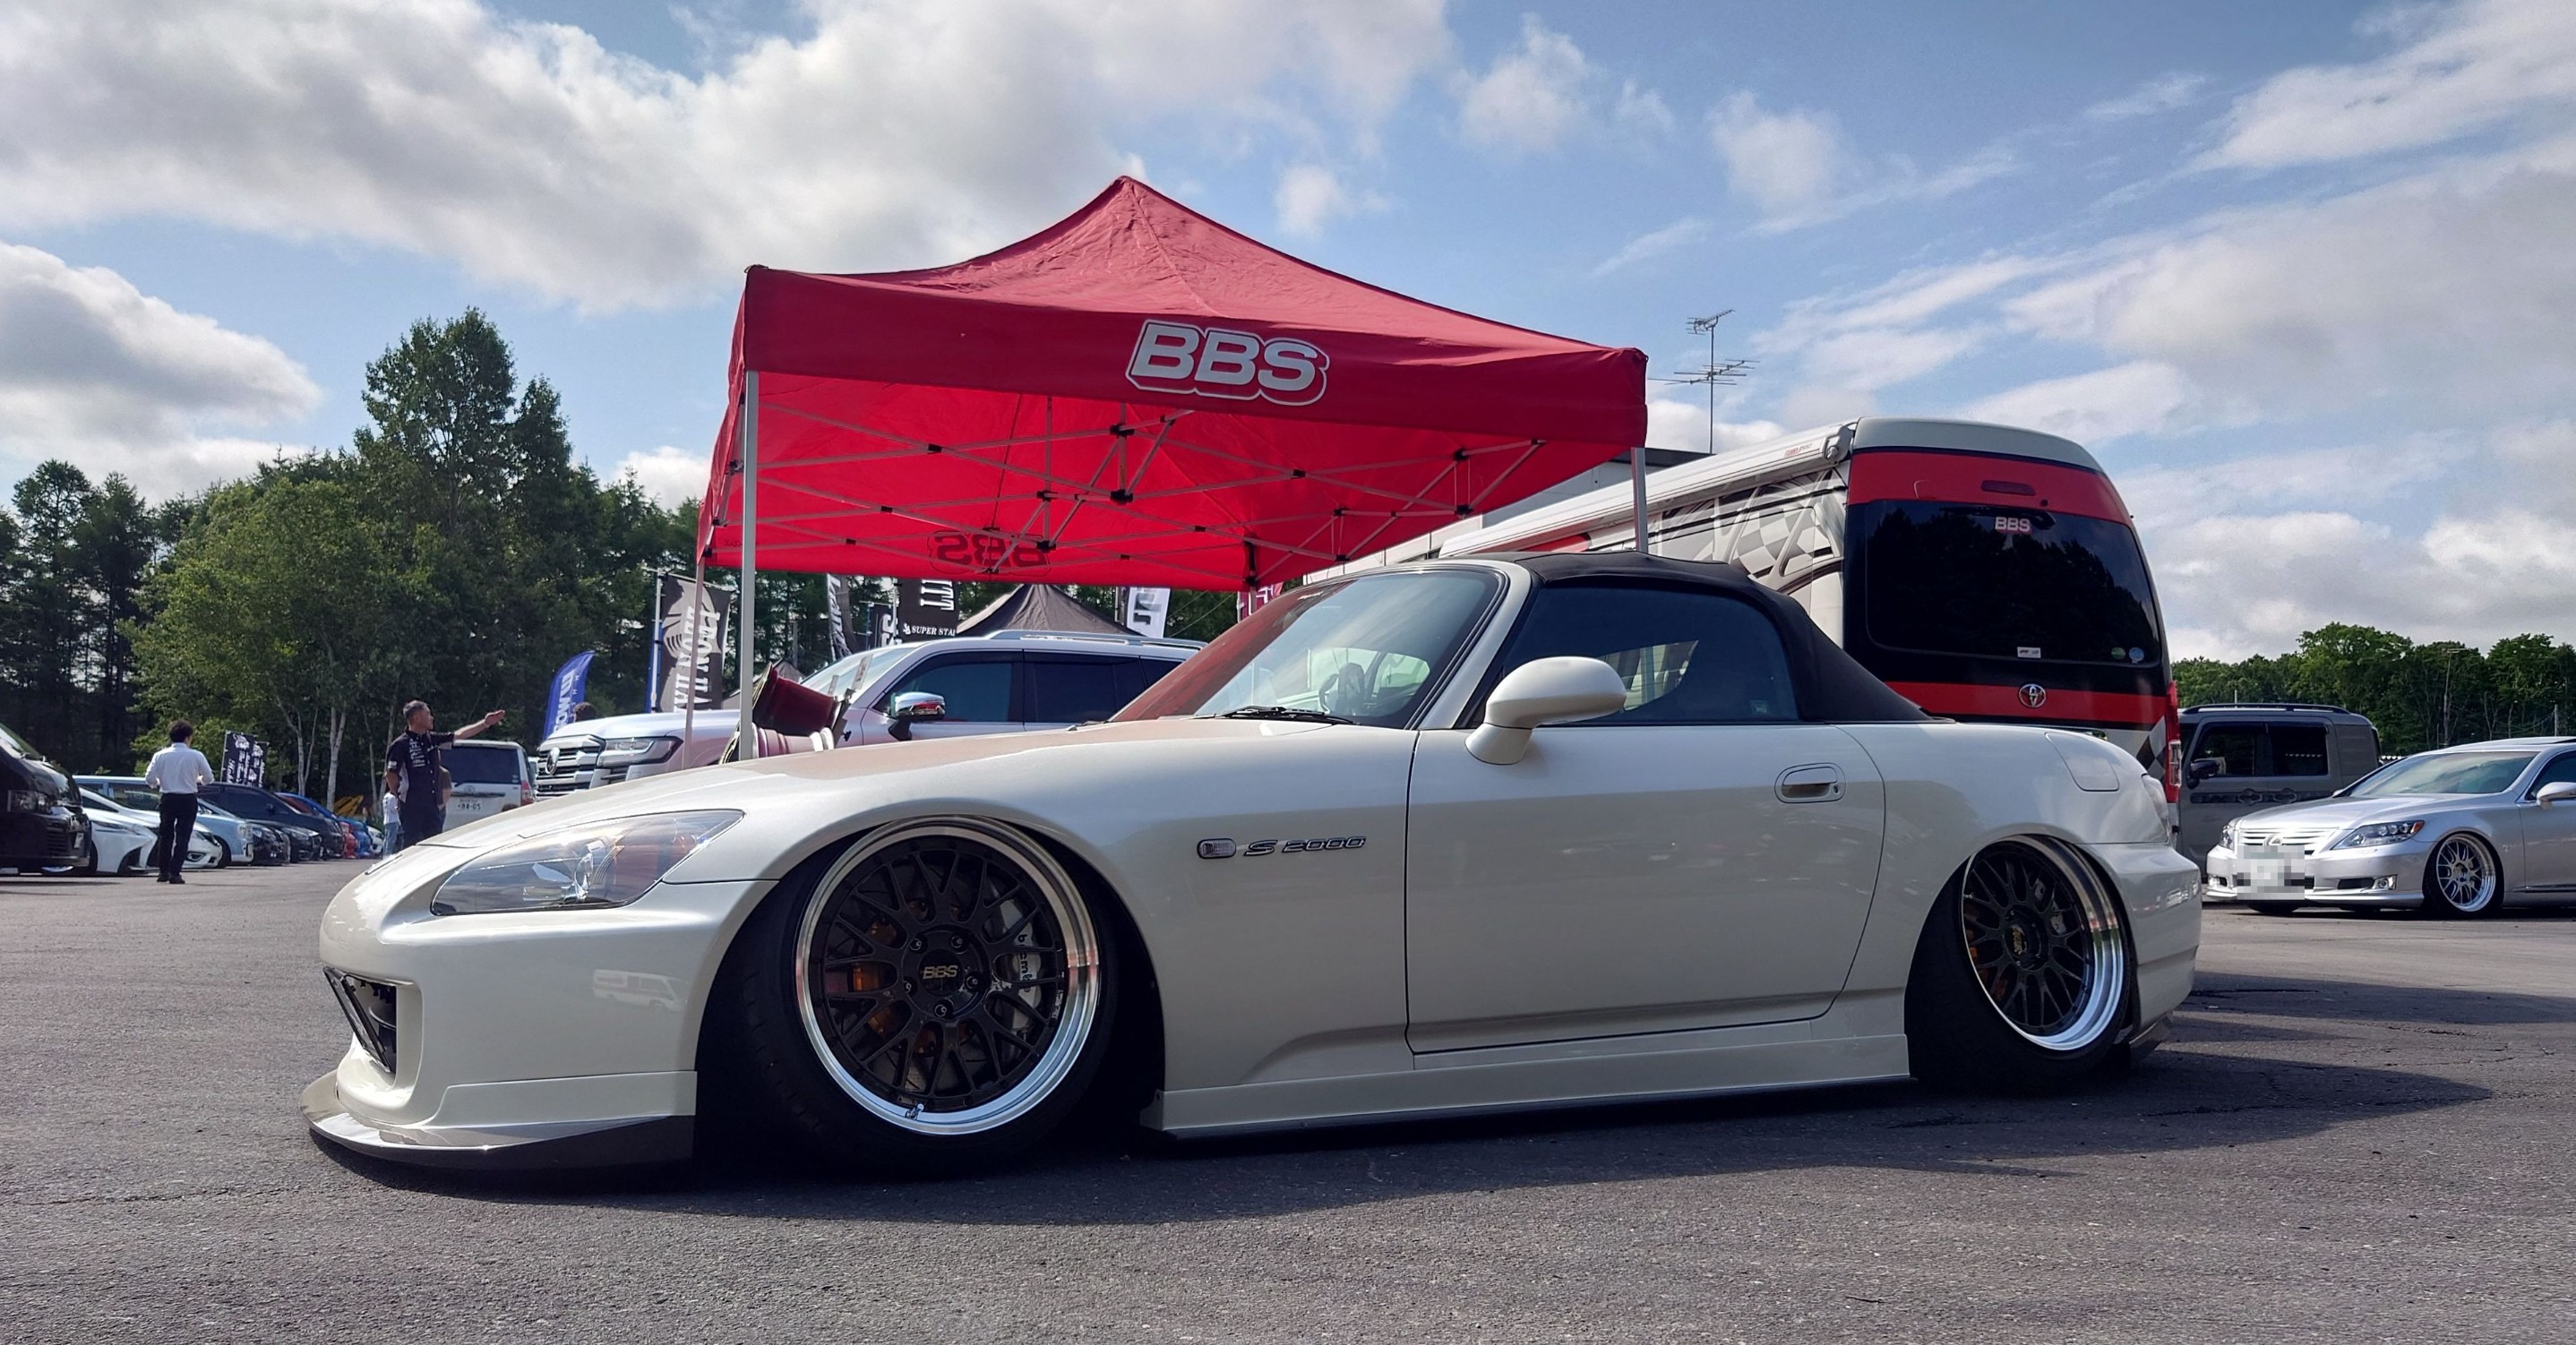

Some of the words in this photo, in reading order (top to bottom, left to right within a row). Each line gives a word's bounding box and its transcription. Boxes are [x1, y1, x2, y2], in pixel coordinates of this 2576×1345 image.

[1126, 320, 1329, 406] BBS
[1995, 517, 2031, 533] BBS
[912, 626, 937, 635] SUPER
[1243, 839, 1278, 857] S
[1282, 836, 1367, 853] 2000
[923, 964, 958, 980] BBS
